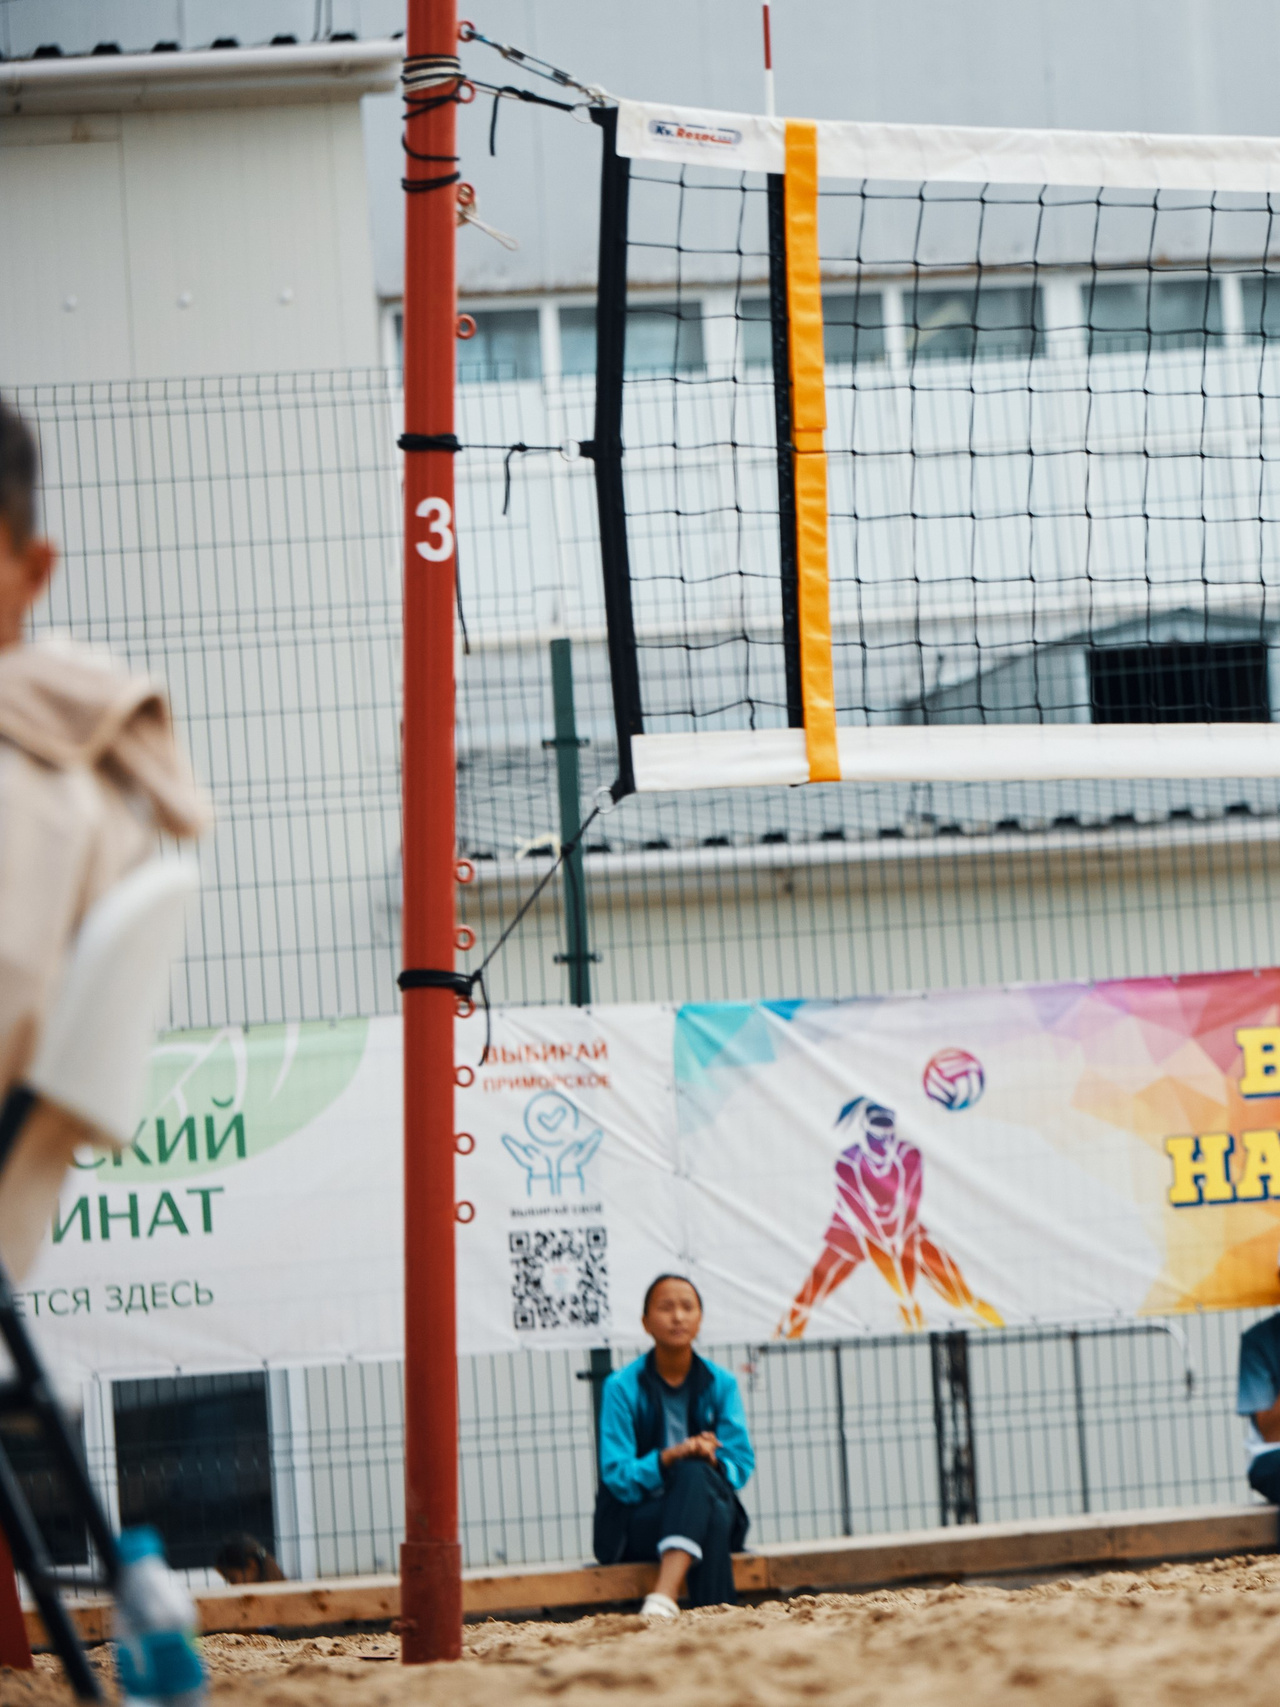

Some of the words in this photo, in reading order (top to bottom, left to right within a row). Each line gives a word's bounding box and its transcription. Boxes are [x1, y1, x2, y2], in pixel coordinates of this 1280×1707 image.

[416, 497, 453, 562] 3
[482, 1036, 608, 1064] ВЫБИРАЙ
[105, 1280, 215, 1316] ЗДЕСЬ
